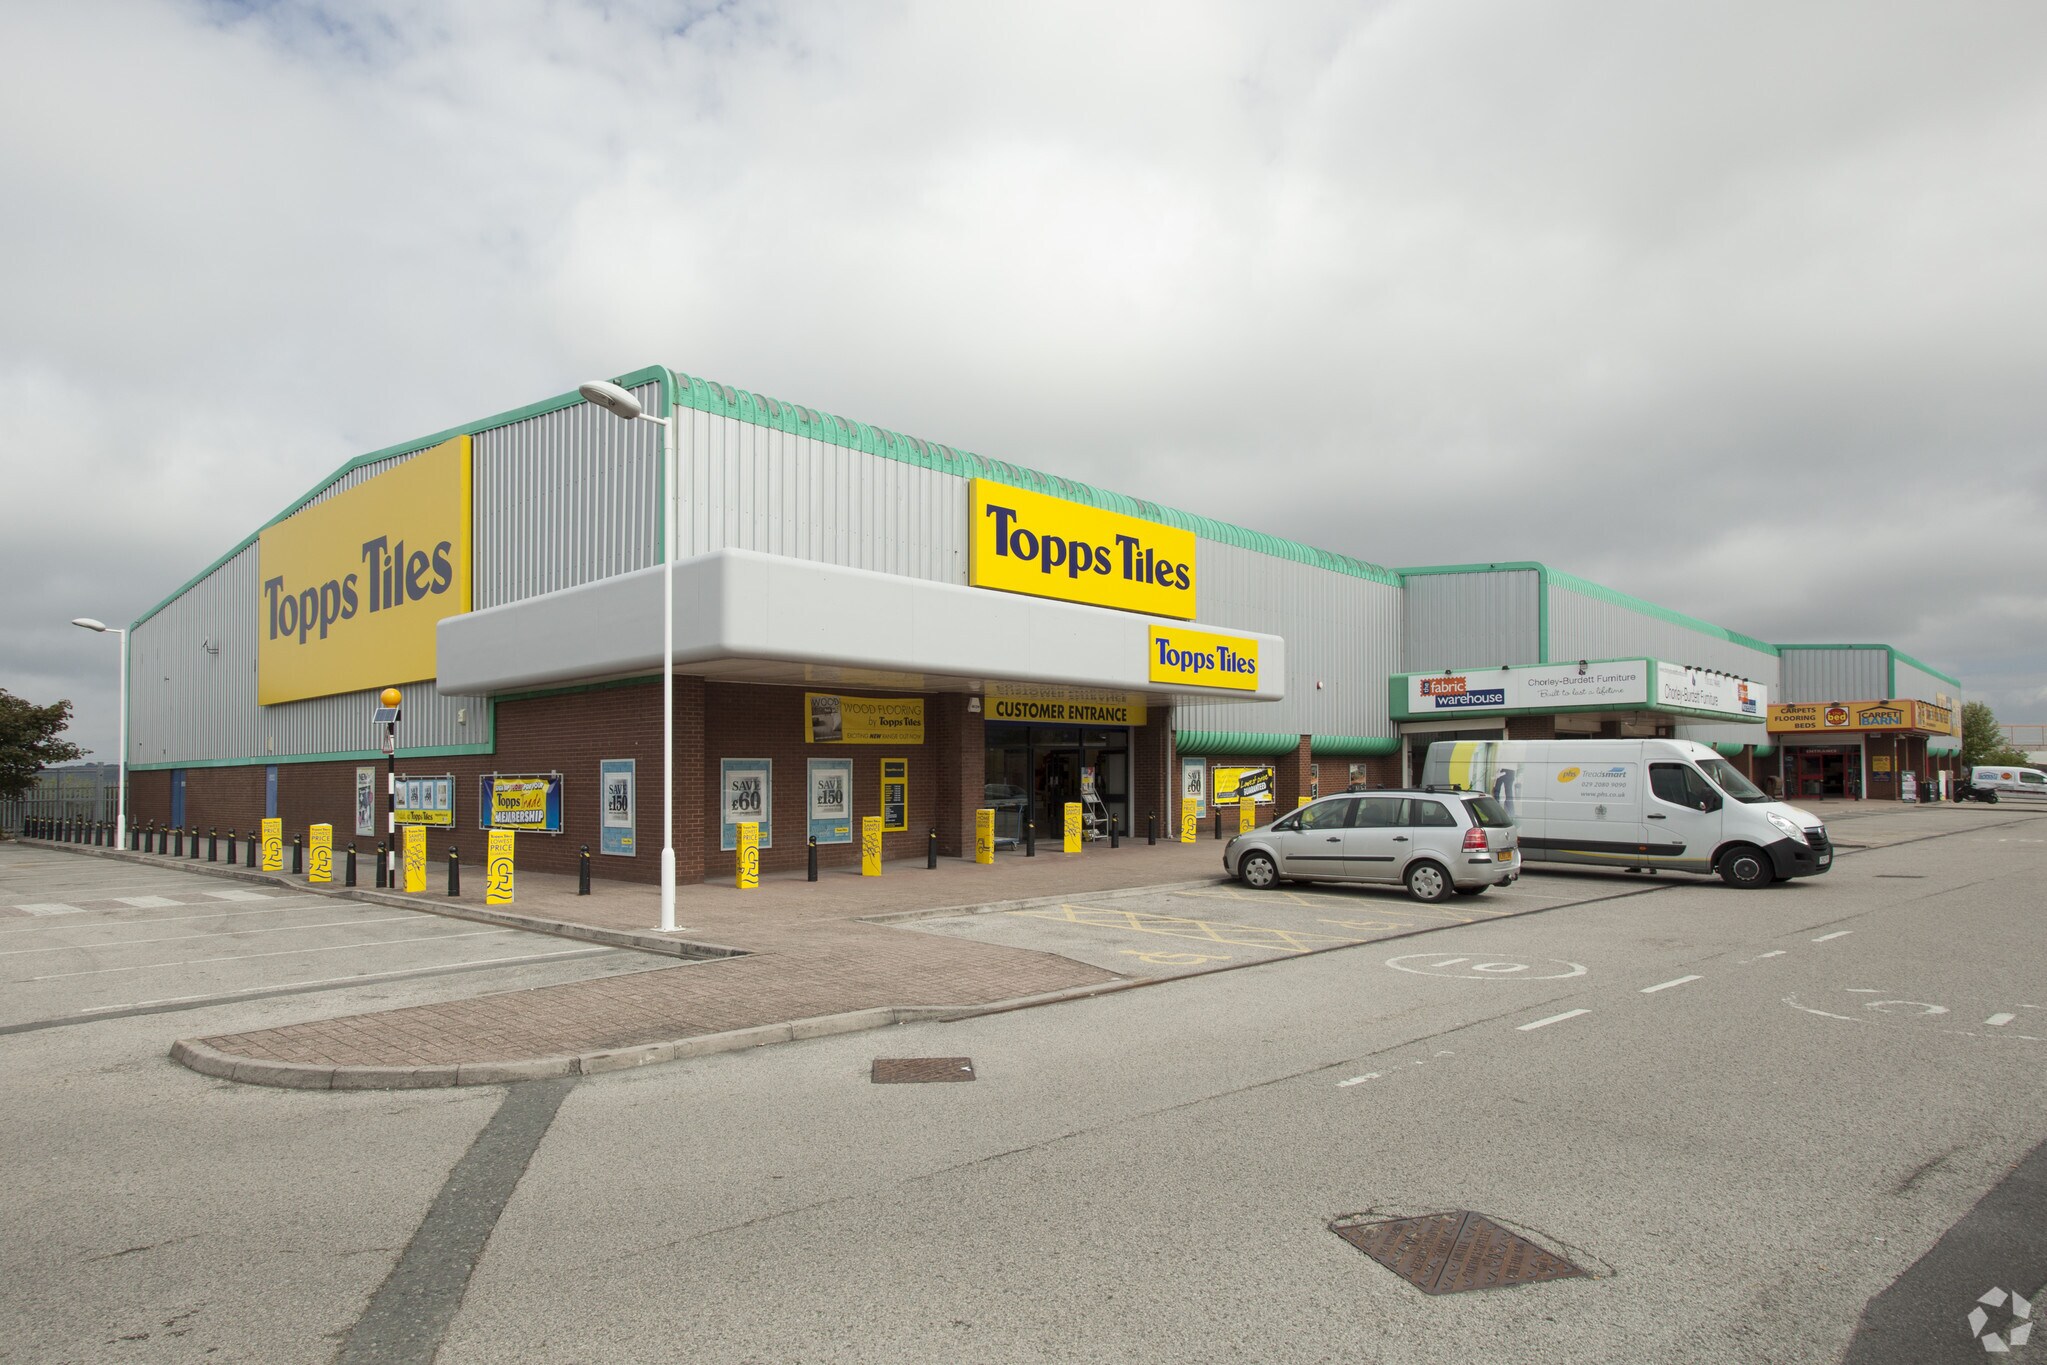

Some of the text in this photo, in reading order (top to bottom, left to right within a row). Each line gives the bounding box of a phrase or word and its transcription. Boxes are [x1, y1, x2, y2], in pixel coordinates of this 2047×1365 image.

[986, 503, 1190, 591] Topps Tiles
[264, 535, 453, 645] Topps Tiles
[1155, 637, 1256, 675] Topps Tiles
[1431, 680, 1464, 693] fabric
[1527, 674, 1636, 687] Chorley-Burdett Furniture
[811, 697, 839, 706] WOOD
[1437, 692, 1503, 705] warehouse
[843, 702, 876, 714] WOOD
[877, 704, 922, 715] FLOORING
[996, 701, 1127, 722] CUSTOMER ENTRANCE
[868, 717, 922, 727] by Topps Tiles
[1827, 712, 1848, 721] bed
[1861, 717, 1899, 725] BARN
[1563, 770, 1577, 779] phs
[1582, 770, 1627, 778] Treadsmart
[608, 784, 628, 795] SAVE
[732, 780, 761, 791] SAVE
[817, 779, 842, 790] SAVE
[1187, 779, 1201, 792] £60
[496, 793, 541, 809] Topps Trade
[608, 794, 628, 811] £150
[731, 791, 761, 811] £60
[817, 789, 843, 805] £150
[410, 811, 422, 821] Topps
[423, 811, 433, 820] Tiles
[495, 810, 544, 823] MEMBERSHIP
